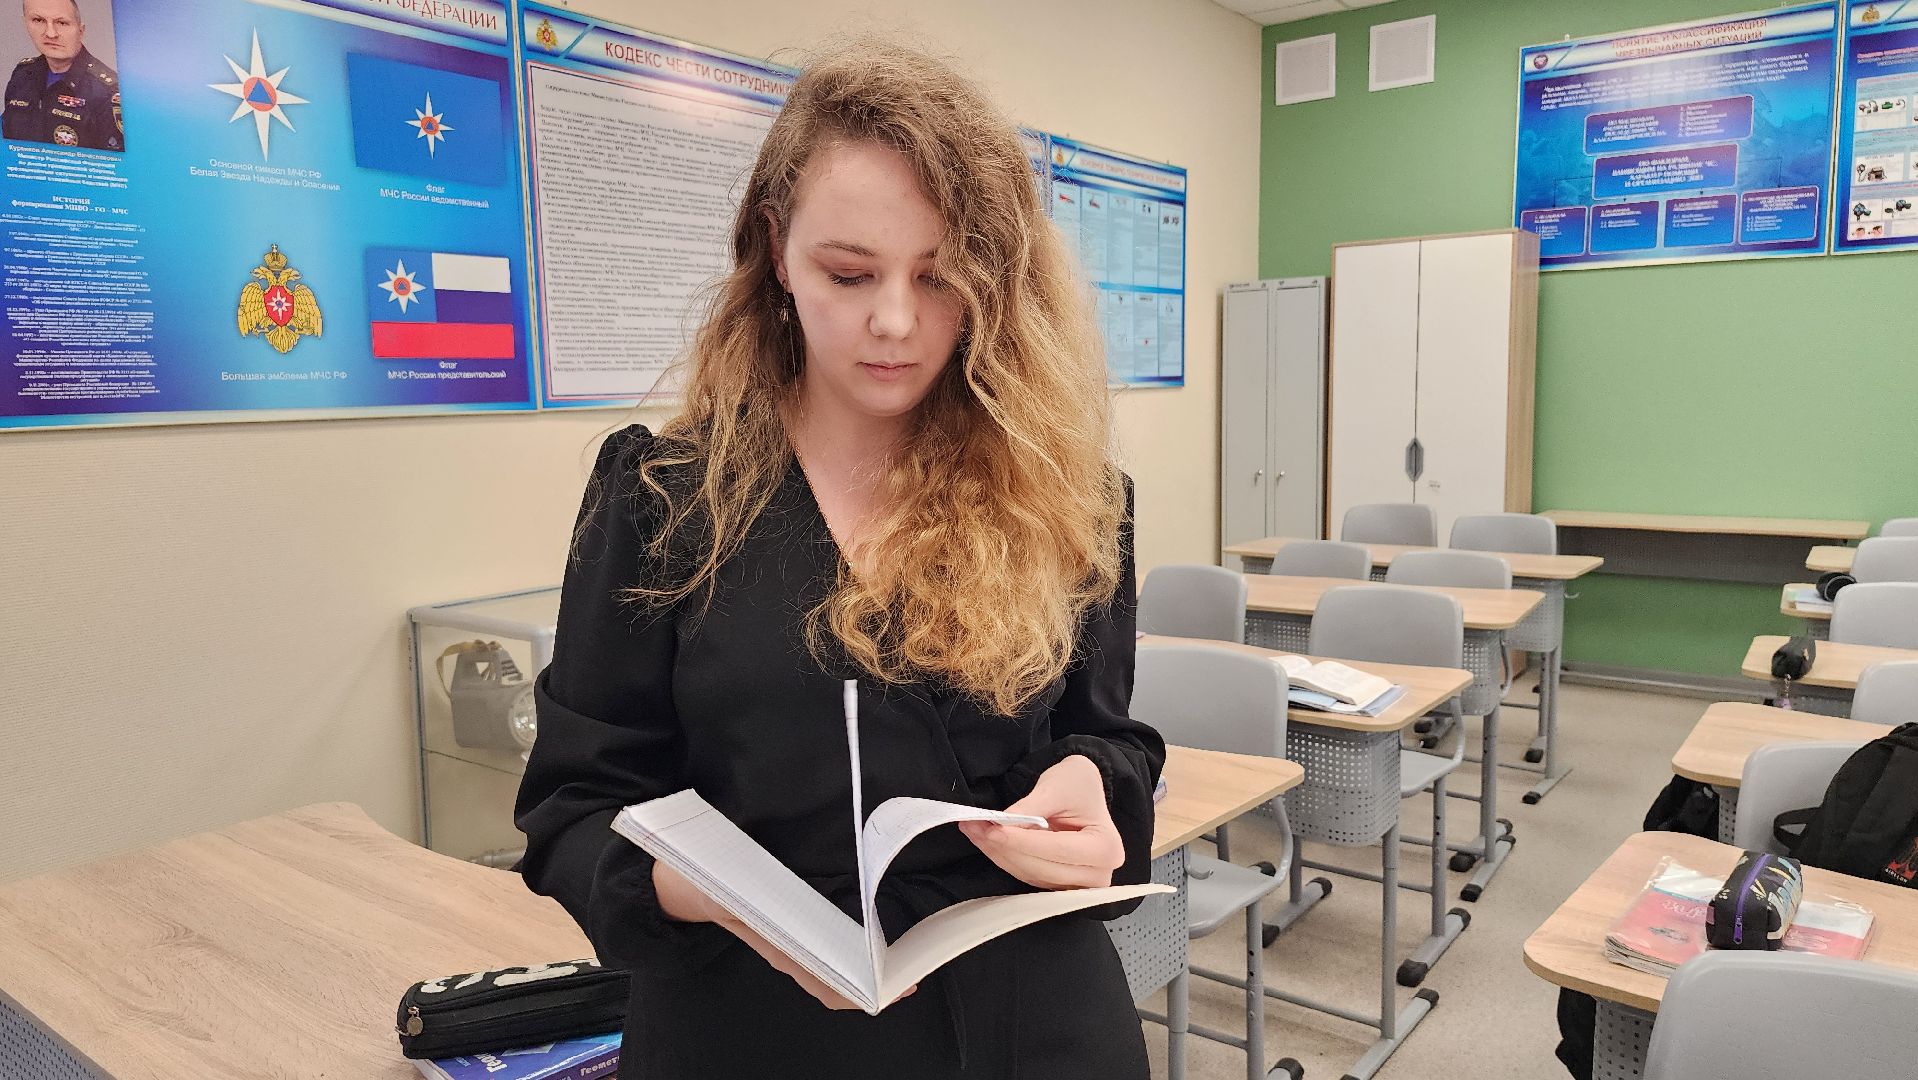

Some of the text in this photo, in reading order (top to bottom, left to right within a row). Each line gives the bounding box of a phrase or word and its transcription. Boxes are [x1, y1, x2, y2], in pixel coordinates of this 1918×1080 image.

[1612, 36, 1658, 49] ПОНЯТИЕ
[1672, 18, 1767, 40] КЛАССИФИКАЦИЯ
[1705, 31, 1762, 48] СИТУАЦИЙ
[605, 41, 790, 97] КОДЕКС ЧЕСТИ СОТРУДНИК
[190, 166, 218, 177] Белая
[220, 170, 251, 182] Звезда
[253, 174, 292, 186] Надежды
[209, 159, 253, 171] Основной
[288, 168, 307, 177] МЧС
[309, 170, 321, 179] РФ
[380, 188, 400, 199] МЧС
[402, 191, 430, 202] России
[425, 183, 446, 194] Флаг
[221, 371, 266, 382] Большая
[310, 371, 332, 380] МЧС
[334, 370, 348, 380] РФ
[387, 370, 408, 379] МЧС
[409, 370, 436, 379] России
